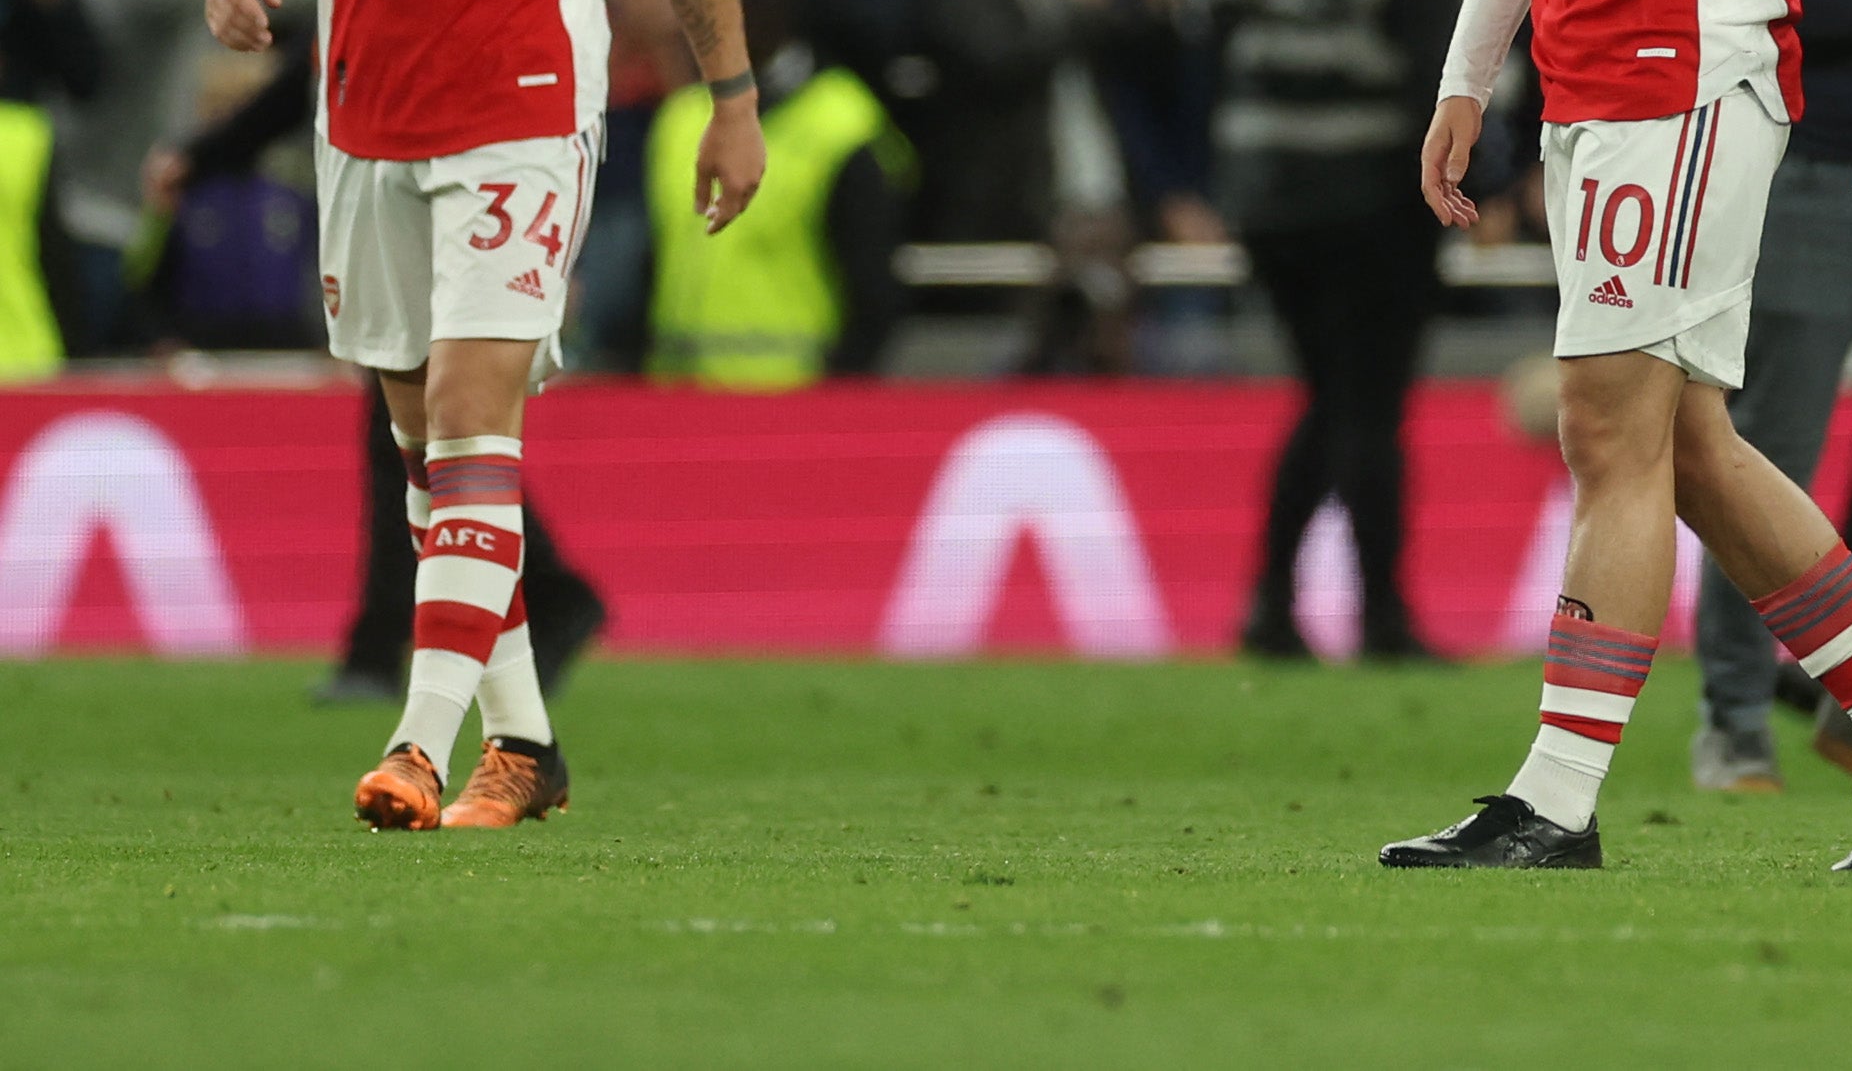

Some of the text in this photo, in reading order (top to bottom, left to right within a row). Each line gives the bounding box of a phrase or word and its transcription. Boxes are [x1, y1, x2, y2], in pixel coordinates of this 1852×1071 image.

[469, 183, 563, 268] 34
[1576, 177, 1655, 268] 10
[1588, 292, 1634, 309] adidas
[435, 527, 495, 552] AFC
